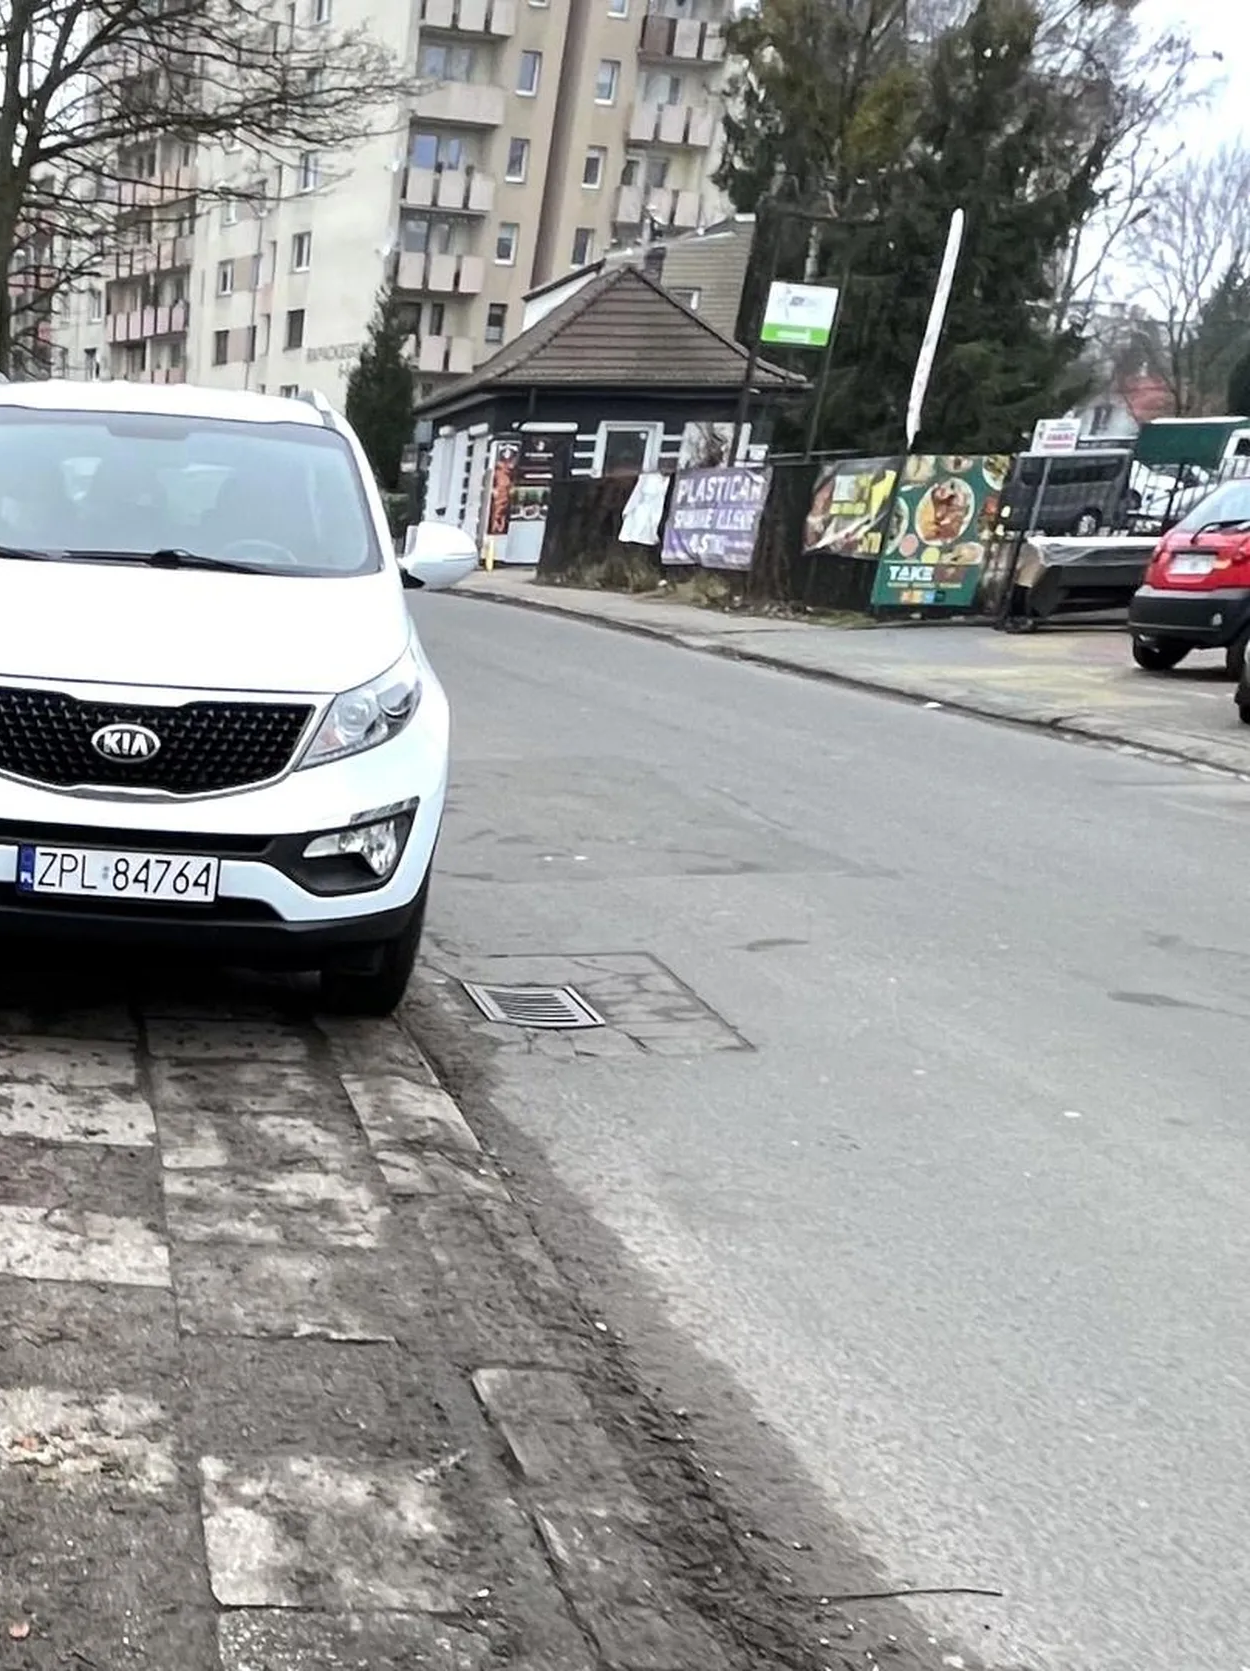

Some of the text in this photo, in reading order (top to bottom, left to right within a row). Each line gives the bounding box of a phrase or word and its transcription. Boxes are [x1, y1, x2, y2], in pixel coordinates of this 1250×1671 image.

[888, 565, 935, 581] TAKE
[103, 731, 149, 756] KIA
[37, 851, 98, 890] ZPL
[112, 857, 212, 897] 84764
